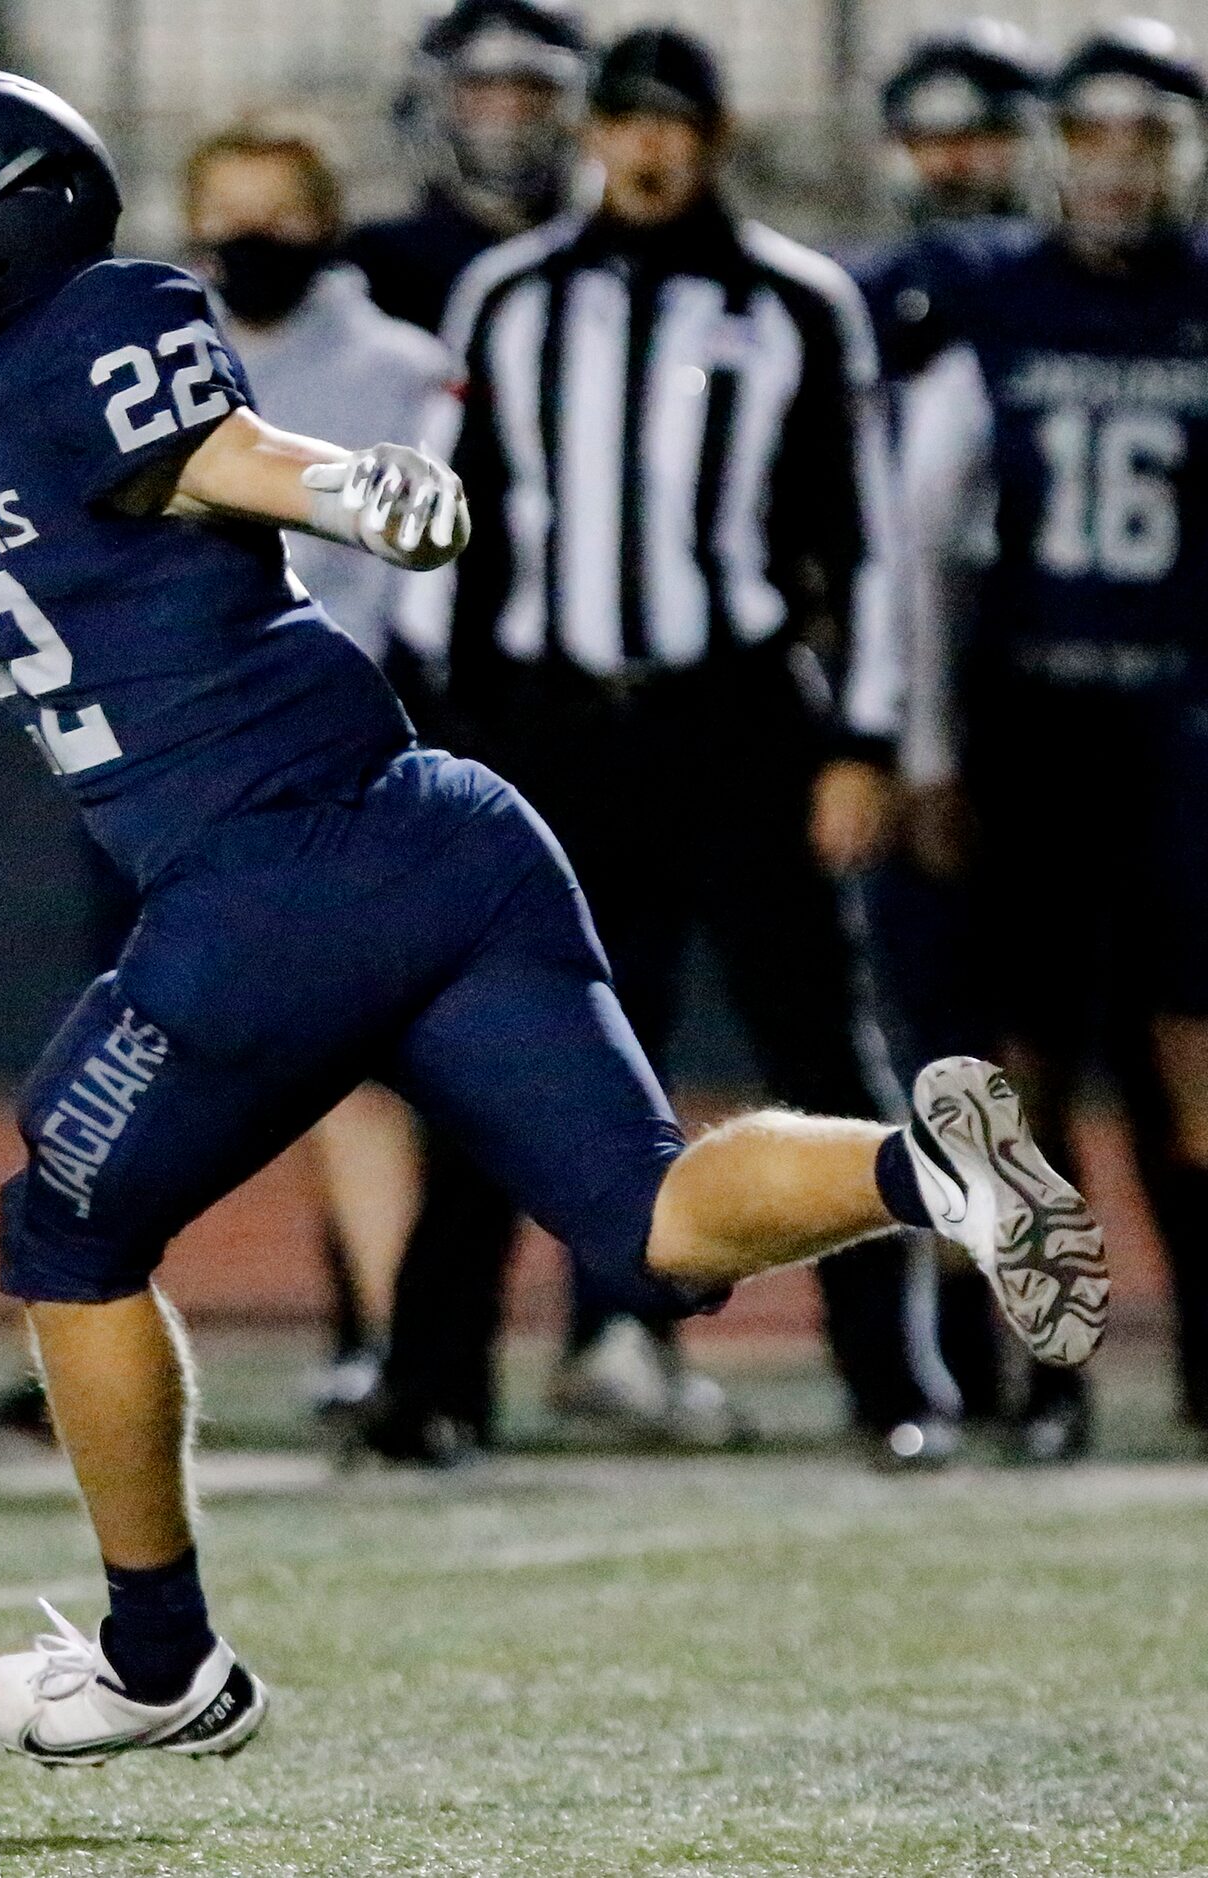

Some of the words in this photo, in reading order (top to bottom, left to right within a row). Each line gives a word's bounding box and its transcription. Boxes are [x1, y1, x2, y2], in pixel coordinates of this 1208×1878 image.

[90, 319, 236, 454] 22
[1035, 410, 1188, 582] 16
[38, 1006, 169, 1219] JAGUARS
[181, 1691, 236, 1742] APOR
